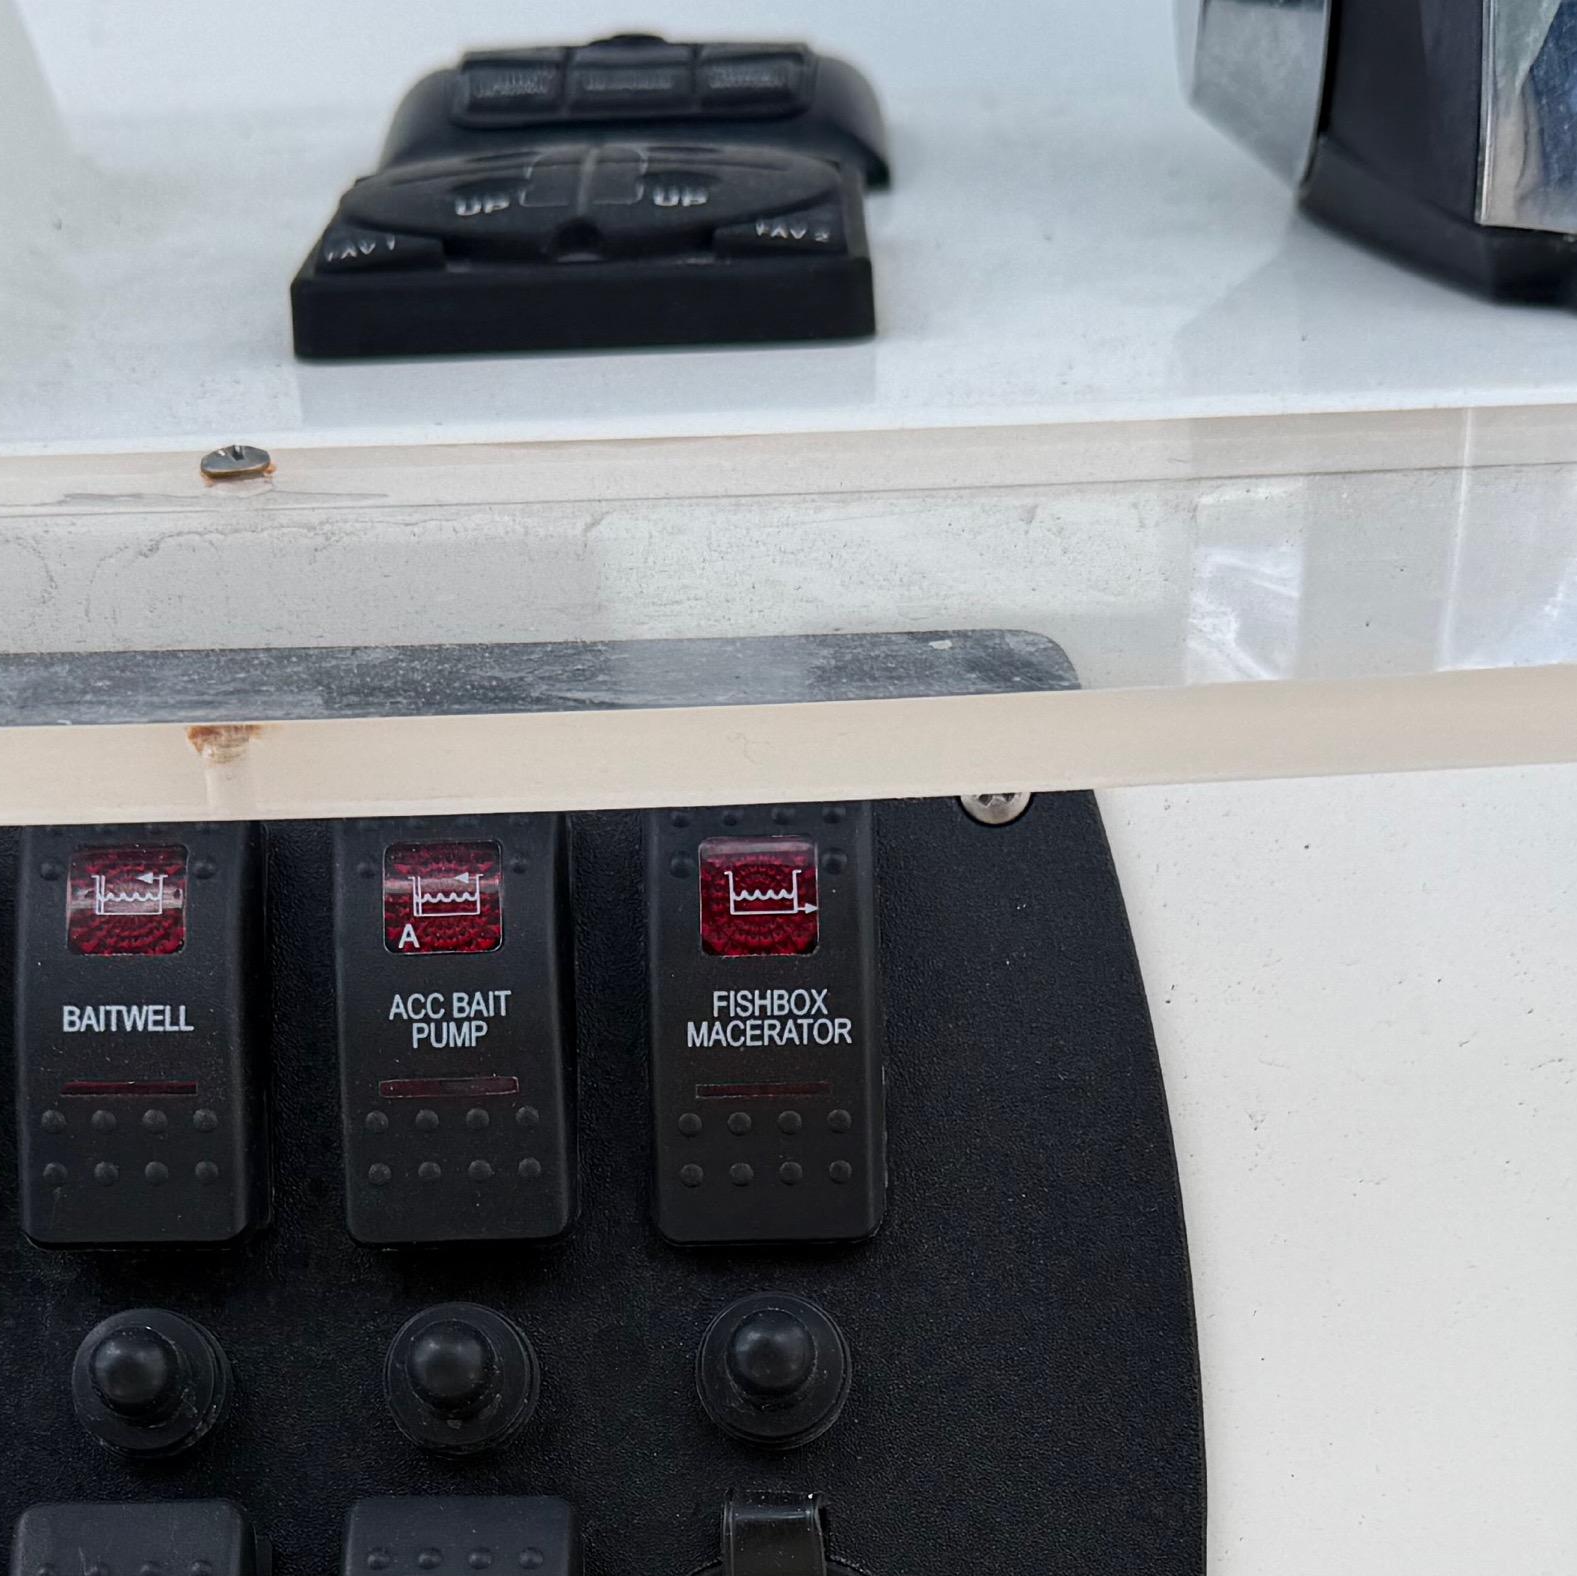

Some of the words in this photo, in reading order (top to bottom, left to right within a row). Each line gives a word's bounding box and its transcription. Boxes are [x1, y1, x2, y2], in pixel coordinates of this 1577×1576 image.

[653, 186, 709, 206] UP
[398, 923, 420, 949] A
[389, 992, 446, 1021] ACC
[451, 990, 512, 1019] BAIT
[713, 988, 828, 1016] FISHBOX
[63, 1004, 195, 1032] BAITWELL
[412, 1021, 488, 1049] PUMP
[687, 1018, 852, 1048] MACERATOR
